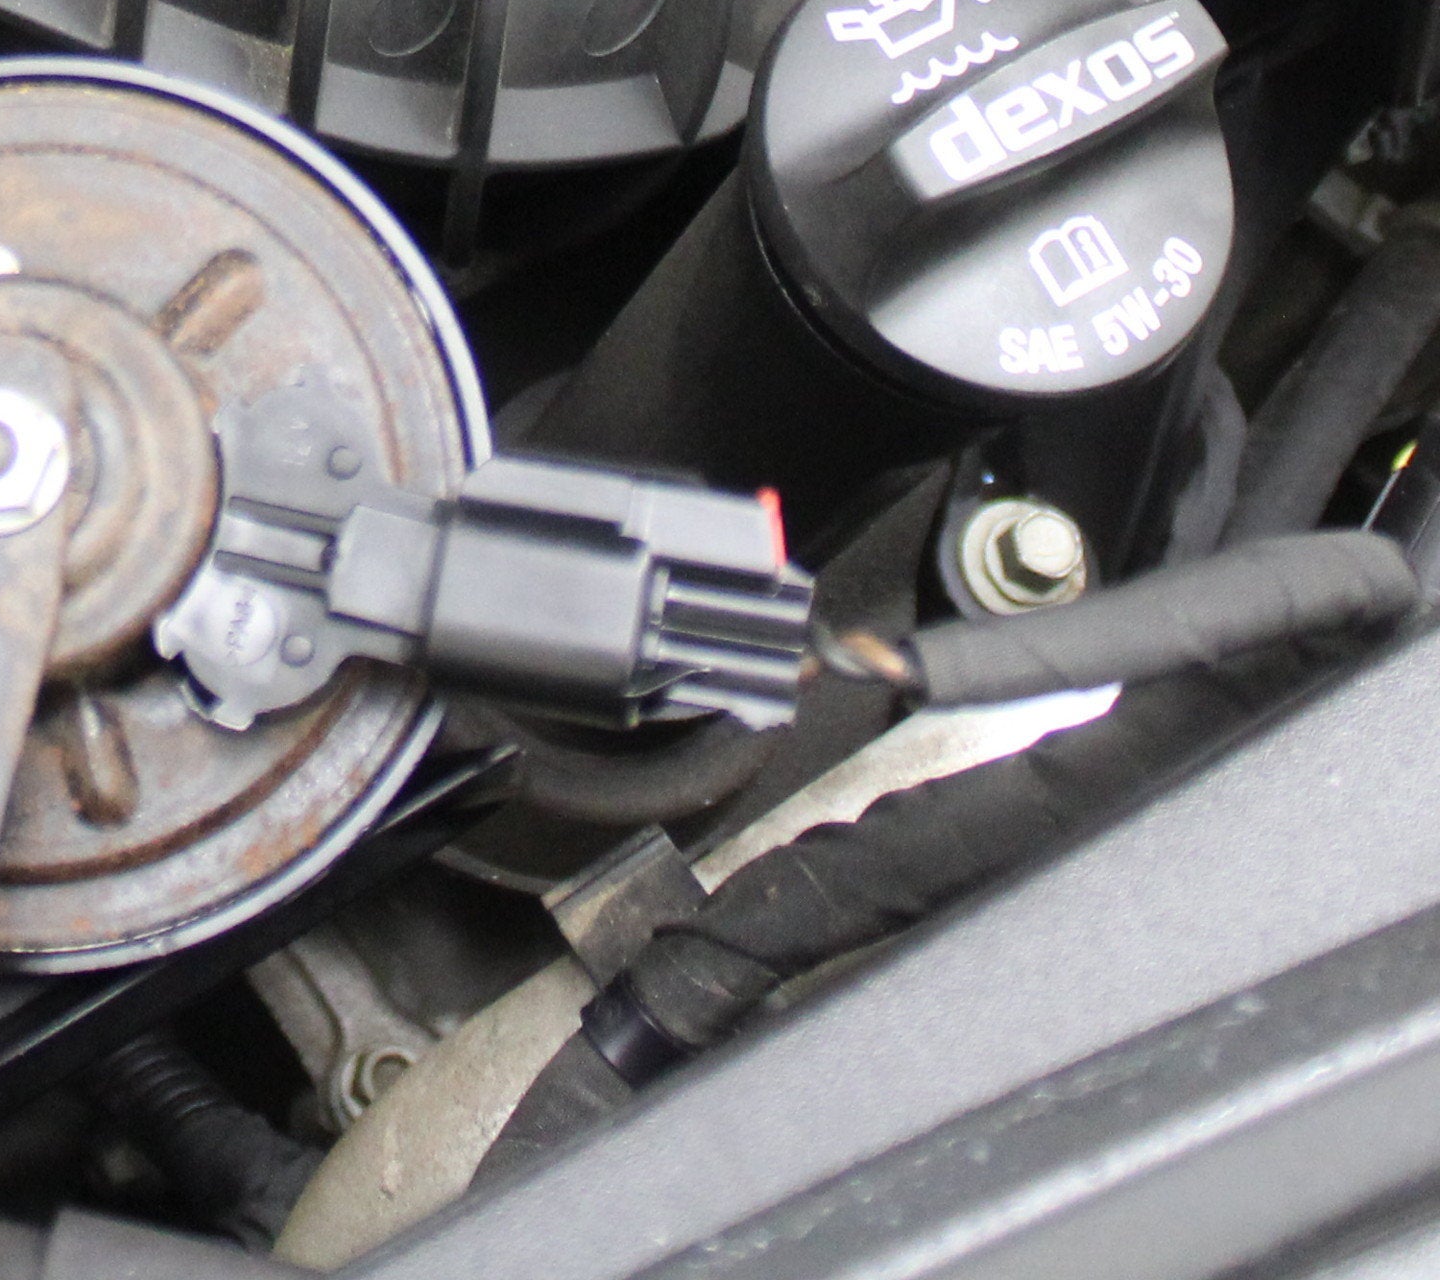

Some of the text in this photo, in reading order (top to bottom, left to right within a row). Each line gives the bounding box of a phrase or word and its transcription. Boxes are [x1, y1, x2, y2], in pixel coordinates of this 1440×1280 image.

[928, 13, 1197, 183] dexos
[997, 235, 1204, 374] SAE 5W-30
